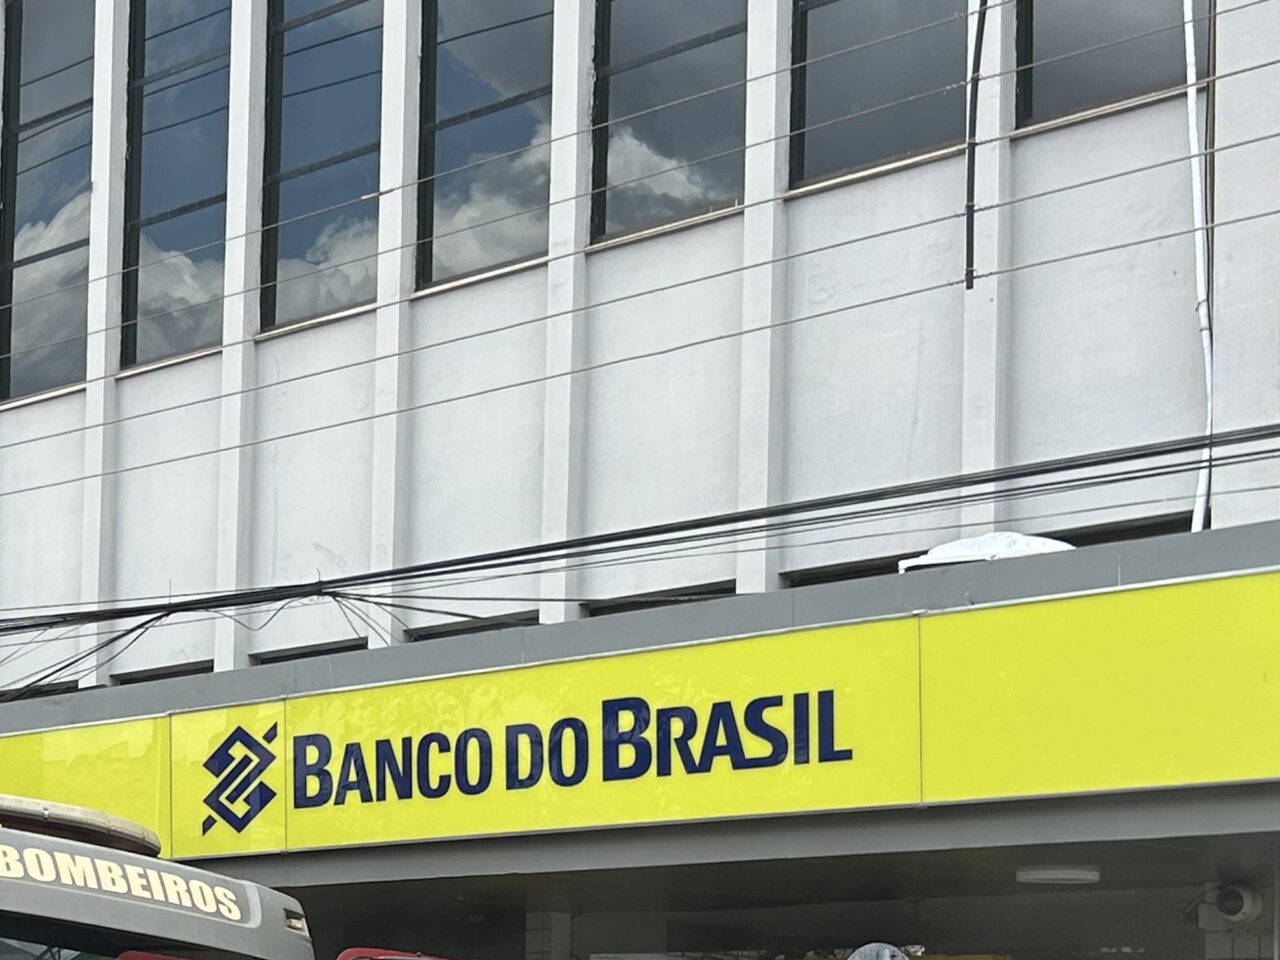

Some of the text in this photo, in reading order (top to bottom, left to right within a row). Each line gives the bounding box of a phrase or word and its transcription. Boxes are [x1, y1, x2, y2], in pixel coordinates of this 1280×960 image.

[293, 689, 853, 809] BANCO DO BRASIL
